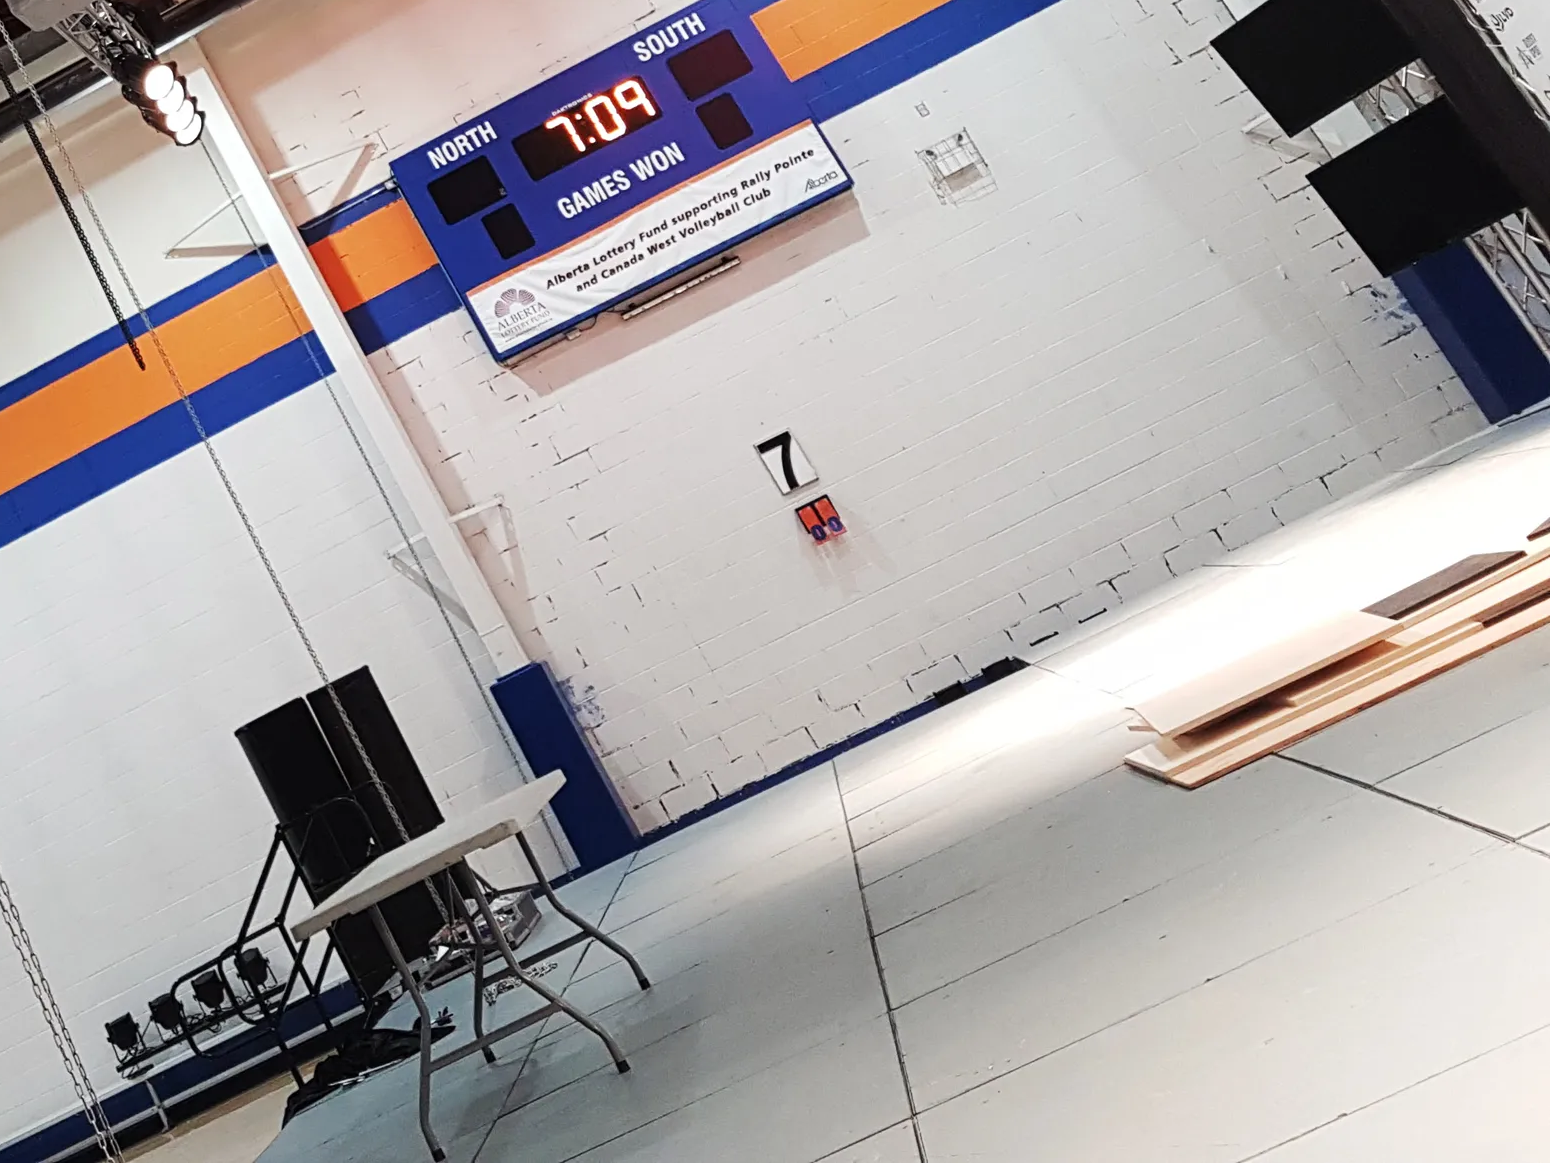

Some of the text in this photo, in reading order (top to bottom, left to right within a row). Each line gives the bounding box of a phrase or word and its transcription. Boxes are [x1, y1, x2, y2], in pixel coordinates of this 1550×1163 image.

[632, 12, 706, 62] SOUTH
[427, 120, 497, 169] NORTH
[545, 80, 656, 152] 7:09
[557, 142, 685, 219] GAMES WON
[546, 149, 814, 290] Alberta Lottery Fund supporting Rally Pointe
[576, 187, 771, 292] and Canada West Volleyball Club
[498, 302, 546, 331] ALBERTA
[757, 431, 799, 490] 7
